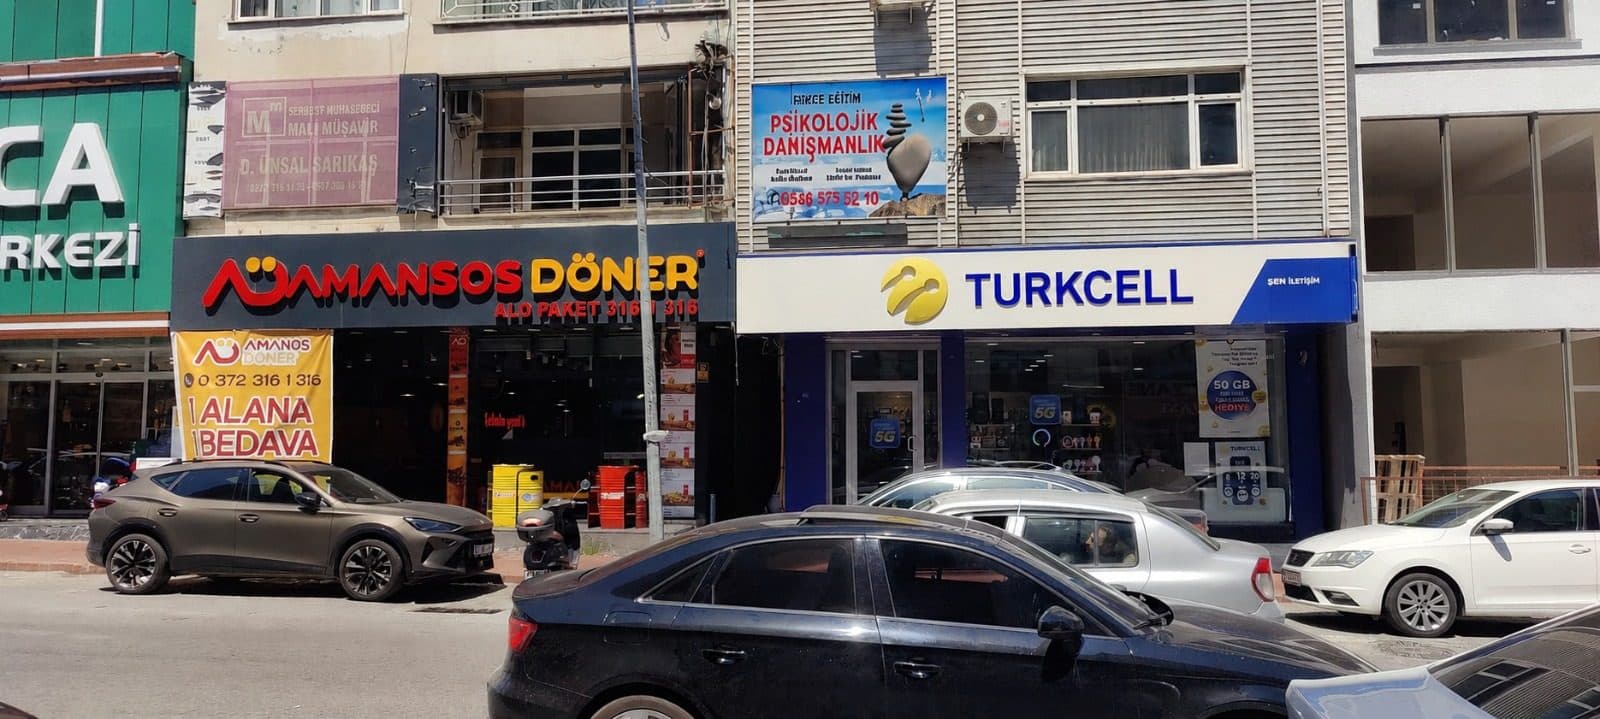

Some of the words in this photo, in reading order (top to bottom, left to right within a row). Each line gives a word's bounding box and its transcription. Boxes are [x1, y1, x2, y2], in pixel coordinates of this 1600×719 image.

[864, 191, 879, 205] 10
[531, 252, 698, 293] DÖNER
[965, 269, 1194, 308] TURKCELL
[496, 301, 531, 317] ALO
[537, 300, 600, 316] PAKET
[608, 301, 640, 316] 316
[664, 300, 698, 315] 316
[245, 340, 310, 351] AMANOS
[198, 375, 209, 386] 0
[215, 374, 246, 386] 372
[253, 374, 280, 386] 316
[286, 374, 291, 386] 1
[296, 373, 321, 386] 316
[1214, 380, 1229, 390] 50
[1233, 380, 1251, 390] GB
[201, 398, 311, 423] ALANA
[200, 430, 318, 456] BEDAVA
[1237, 471, 1246, 480] 12
